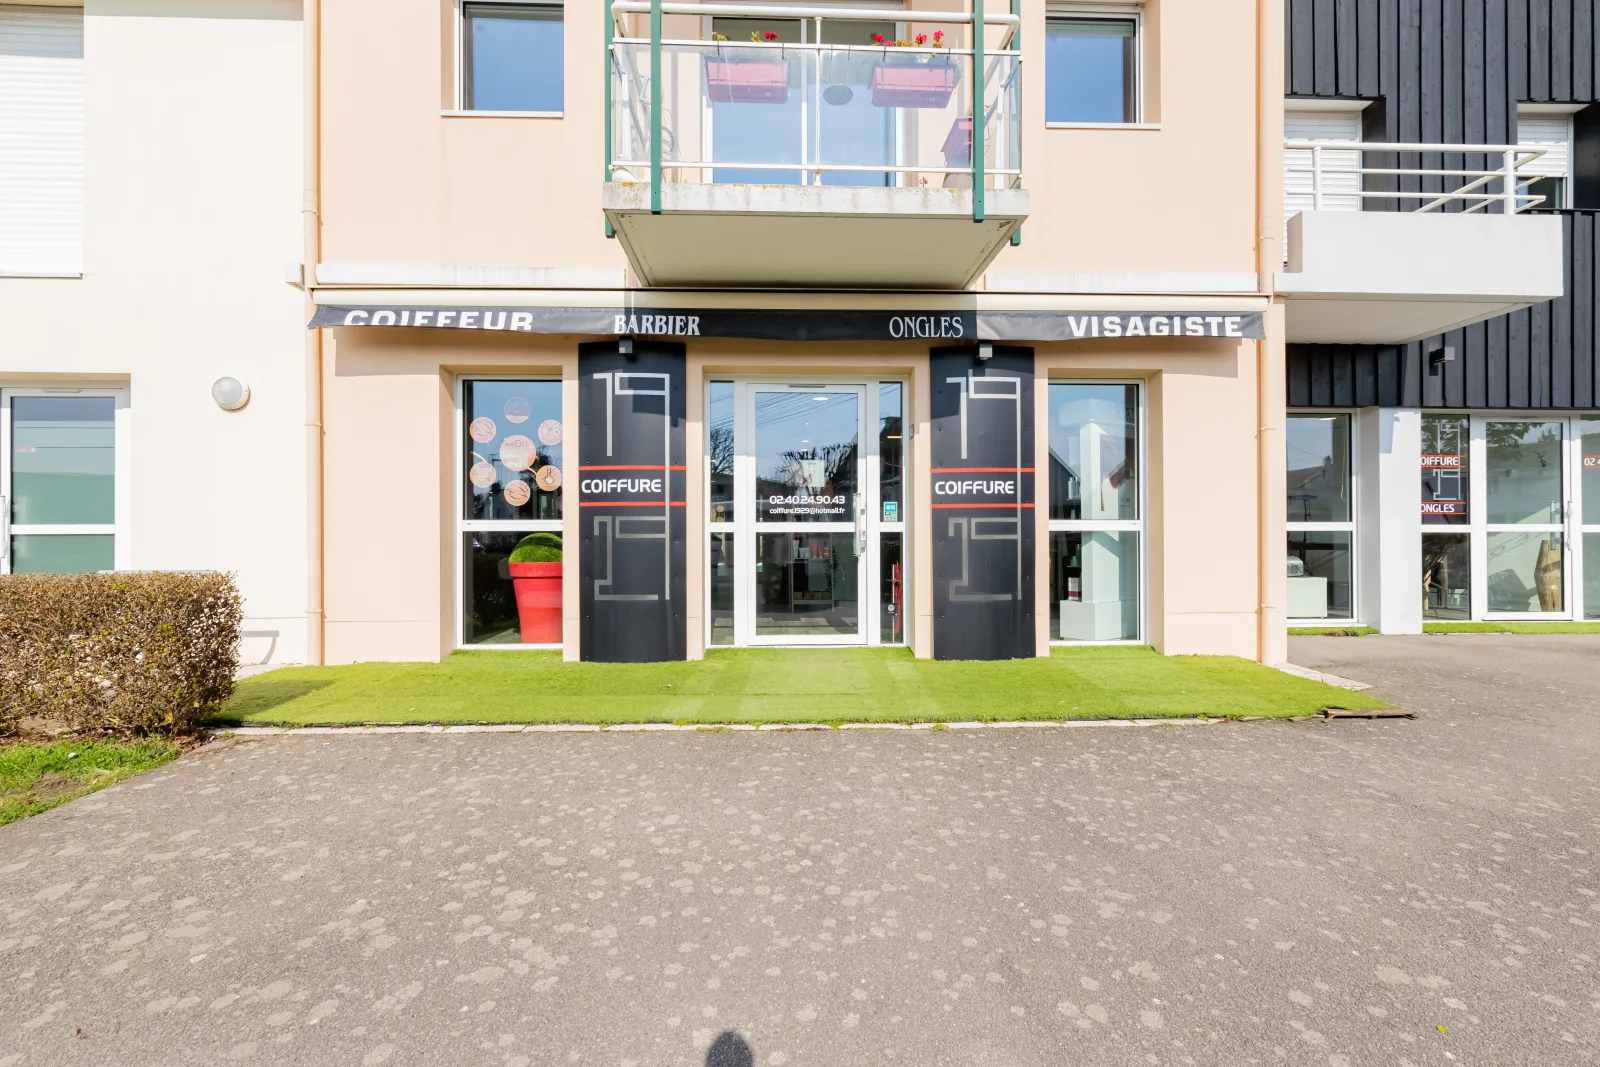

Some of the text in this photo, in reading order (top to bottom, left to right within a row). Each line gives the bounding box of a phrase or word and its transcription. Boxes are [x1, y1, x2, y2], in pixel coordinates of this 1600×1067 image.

[343, 310, 534, 331] COIFFEUR
[614, 315, 701, 336] BARBIER
[888, 316, 964, 338] ONGLES
[1067, 316, 1243, 337] VISAGISTE
[1420, 456, 1459, 466] OIFFURE
[581, 479, 662, 494] COIFFURE
[935, 480, 1014, 495] COIFFURE
[769, 495, 845, 505] 02.40.24.90.43
[1420, 503, 1454, 513] ONGLES
